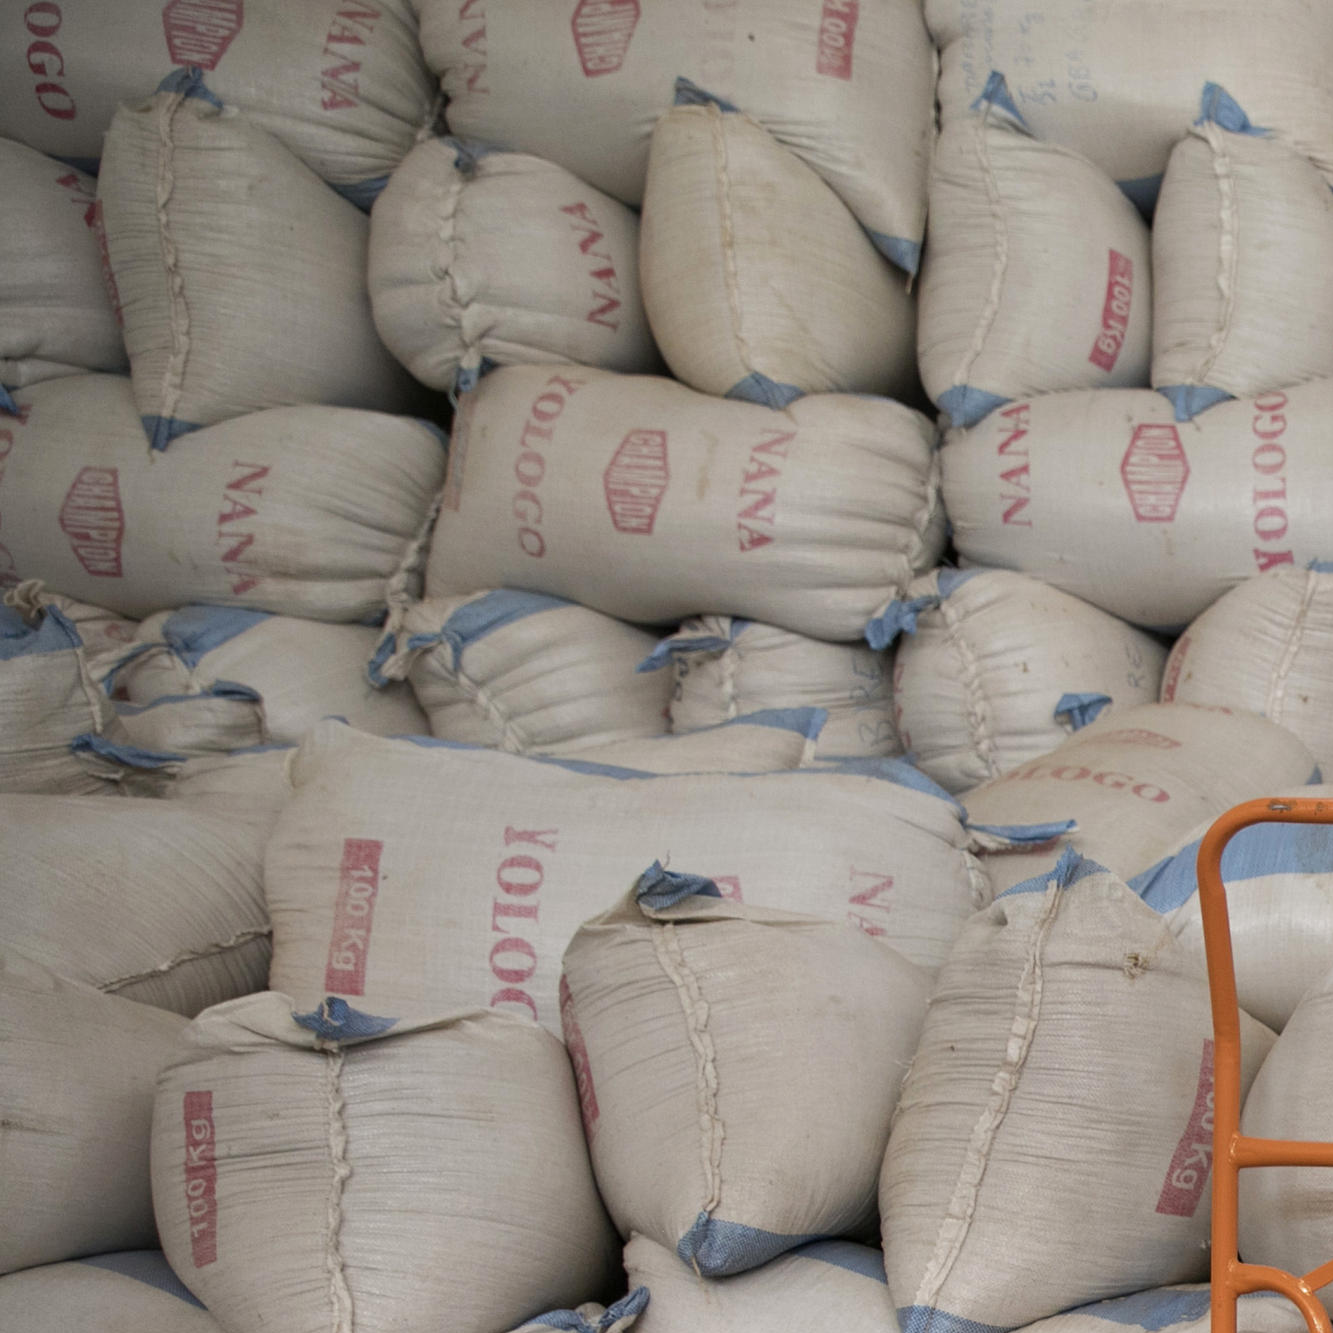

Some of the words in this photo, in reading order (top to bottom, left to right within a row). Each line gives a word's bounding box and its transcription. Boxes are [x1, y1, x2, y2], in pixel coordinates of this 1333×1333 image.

[559, 201, 621, 333] NANA
[1112, 272, 1132, 313] 100
[1099, 318, 1125, 354] Kg
[740, 428, 796, 552] NANA
[998, 403, 1032, 528] NANA
[216, 460, 272, 595] NANA
[346, 864, 378, 924] 100
[331, 927, 370, 974] Kg
[188, 1119, 212, 1166] Kg
[1172, 1133, 1212, 1190] Kg
[187, 1172, 209, 1237] 100
